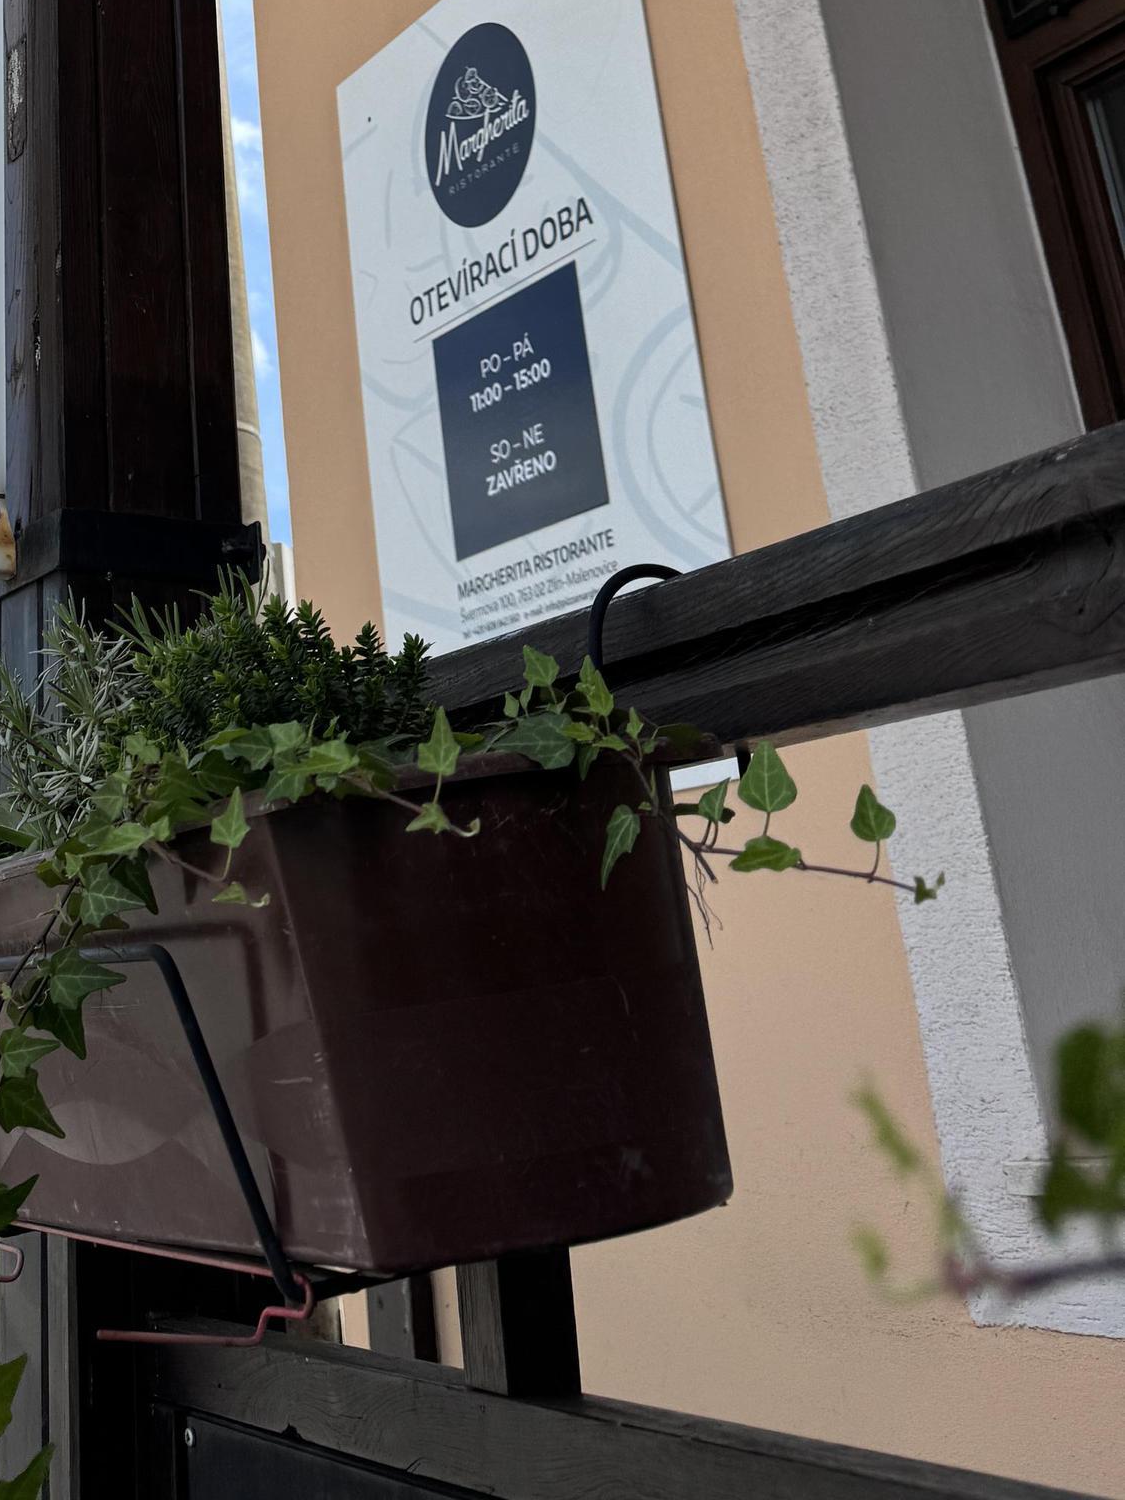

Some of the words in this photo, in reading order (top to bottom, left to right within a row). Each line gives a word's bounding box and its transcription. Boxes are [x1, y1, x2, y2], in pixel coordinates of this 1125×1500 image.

[435, 89, 530, 187] Margherita
[448, 142, 520, 196] RISTORANTE
[409, 228, 519, 326] OTEVÍRACÍ
[522, 197, 594, 262] DOBA
[480, 353, 502, 378] PO
[513, 332, 535, 362] PÁ
[469, 382, 503, 413] 11:00
[513, 358, 551, 391] 15:00
[490, 439, 511, 464] SO
[522, 423, 545, 450] NE
[485, 450, 558, 497] ZAVŘENO
[457, 561, 534, 600] MARGHERITA
[534, 528, 616, 574] RISTORANTE
